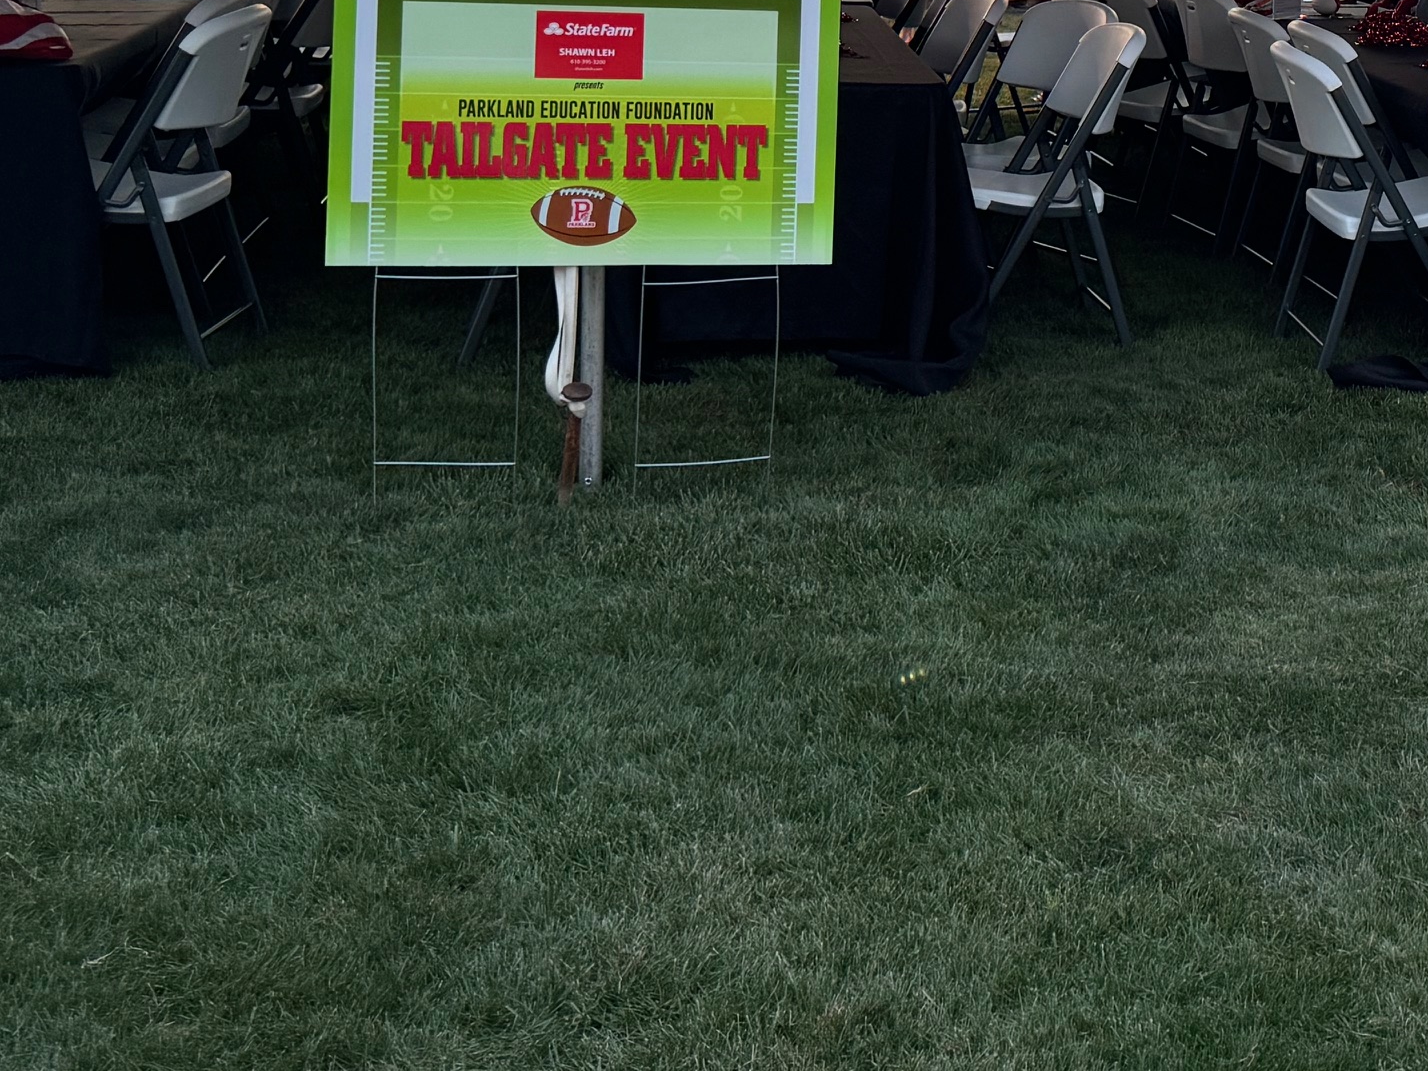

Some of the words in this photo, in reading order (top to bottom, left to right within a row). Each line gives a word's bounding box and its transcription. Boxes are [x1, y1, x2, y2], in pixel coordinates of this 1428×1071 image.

[559, 47, 595, 57] SHAWN
[597, 48, 615, 57] LEH
[573, 81, 604, 91] presents
[458, 99, 534, 118] PARKLAND
[540, 100, 620, 119] EDUCATION
[626, 101, 714, 120] FOUNDATION
[401, 121, 612, 179] TAILGATE
[623, 123, 768, 180] EVENT
